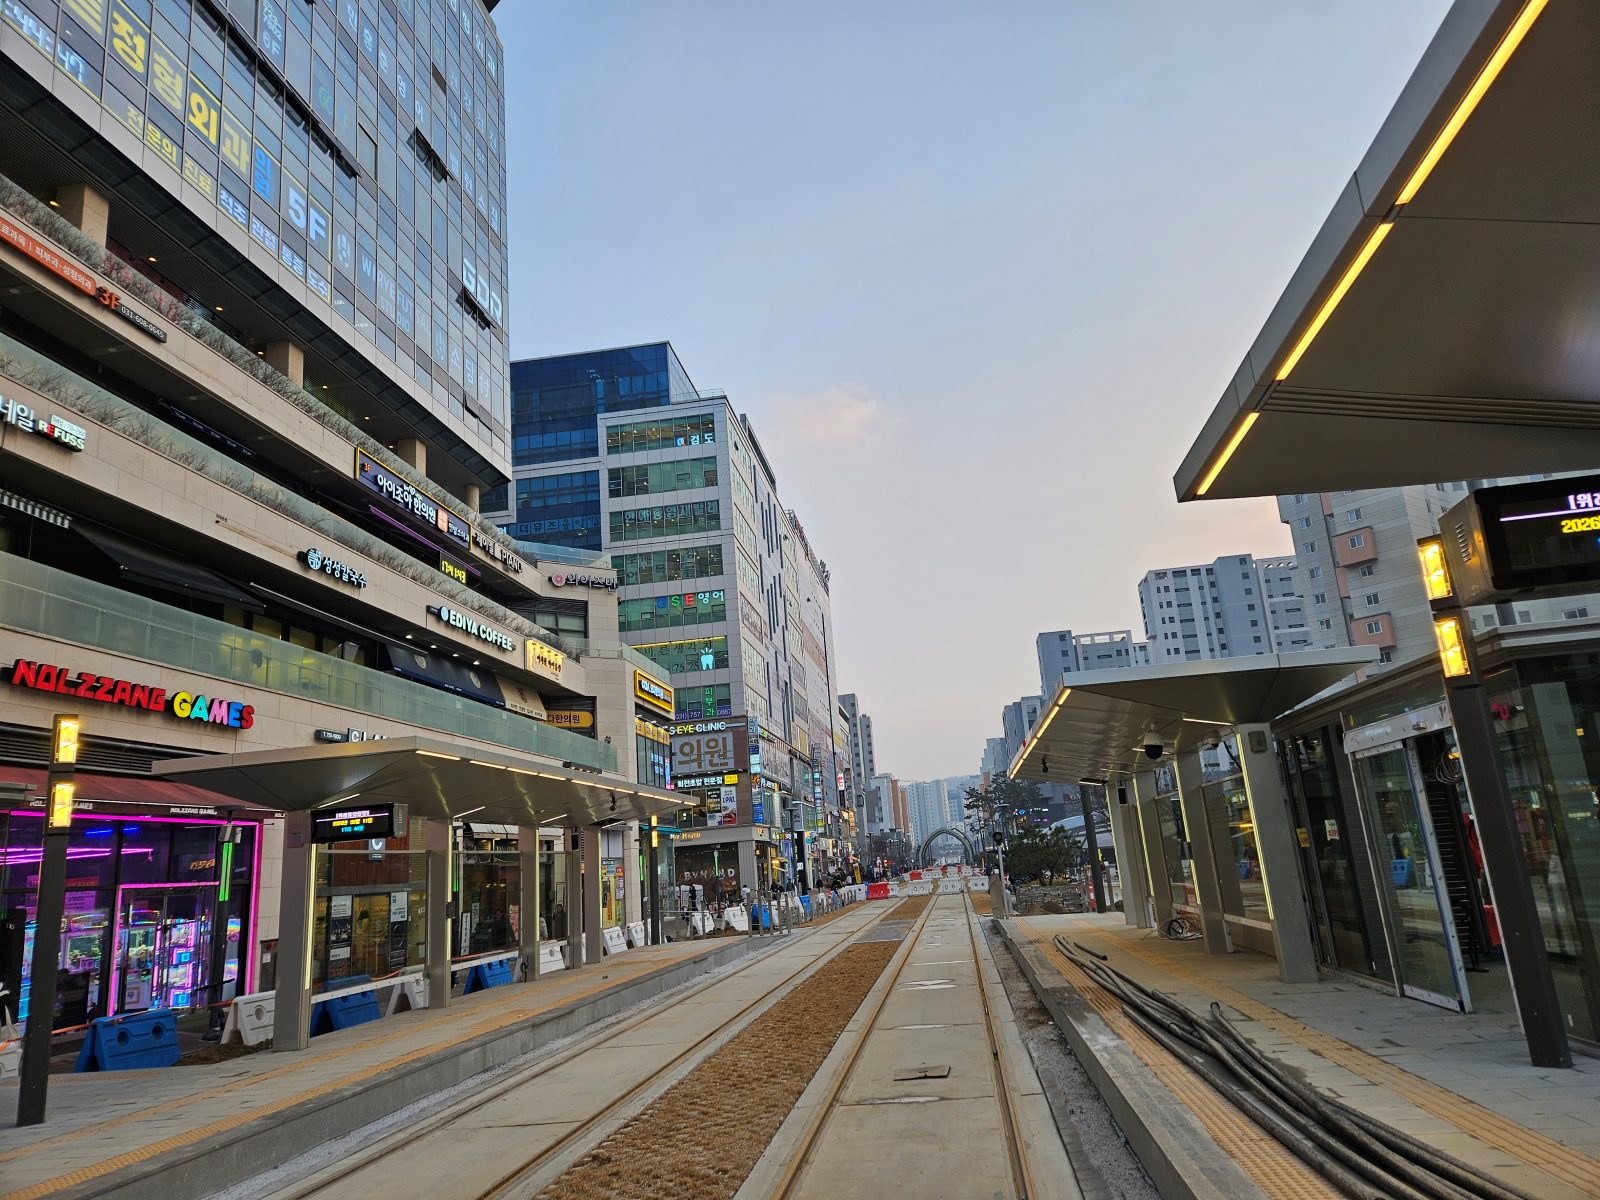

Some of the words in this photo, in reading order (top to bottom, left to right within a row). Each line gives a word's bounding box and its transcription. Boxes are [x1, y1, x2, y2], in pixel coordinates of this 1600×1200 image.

[127, 105, 178, 164] 전문의
[183, 156, 213, 195] 진료
[220, 189, 247, 226] 척추
[252, 217, 277, 254] 관절
[281, 244, 305, 277] 통증
[308, 269, 329, 297] 도수
[288, 186, 327, 241] 5F
[98, 286, 121, 309] 3F
[38, 419, 85, 450] REFUSS
[413, 498, 436, 524] 한의원
[1561, 515, 1600, 534] 2026
[500, 549, 523, 574] PIANO
[449, 610, 479, 636] EDIYA
[479, 624, 514, 652] COFFEE
[10, 659, 166, 712] NOLZZANG
[172, 690, 256, 729] GAMES
[677, 724, 695, 735] EYE
[696, 721, 727, 733] CLINIC
[678, 736, 728, 770] 의원
